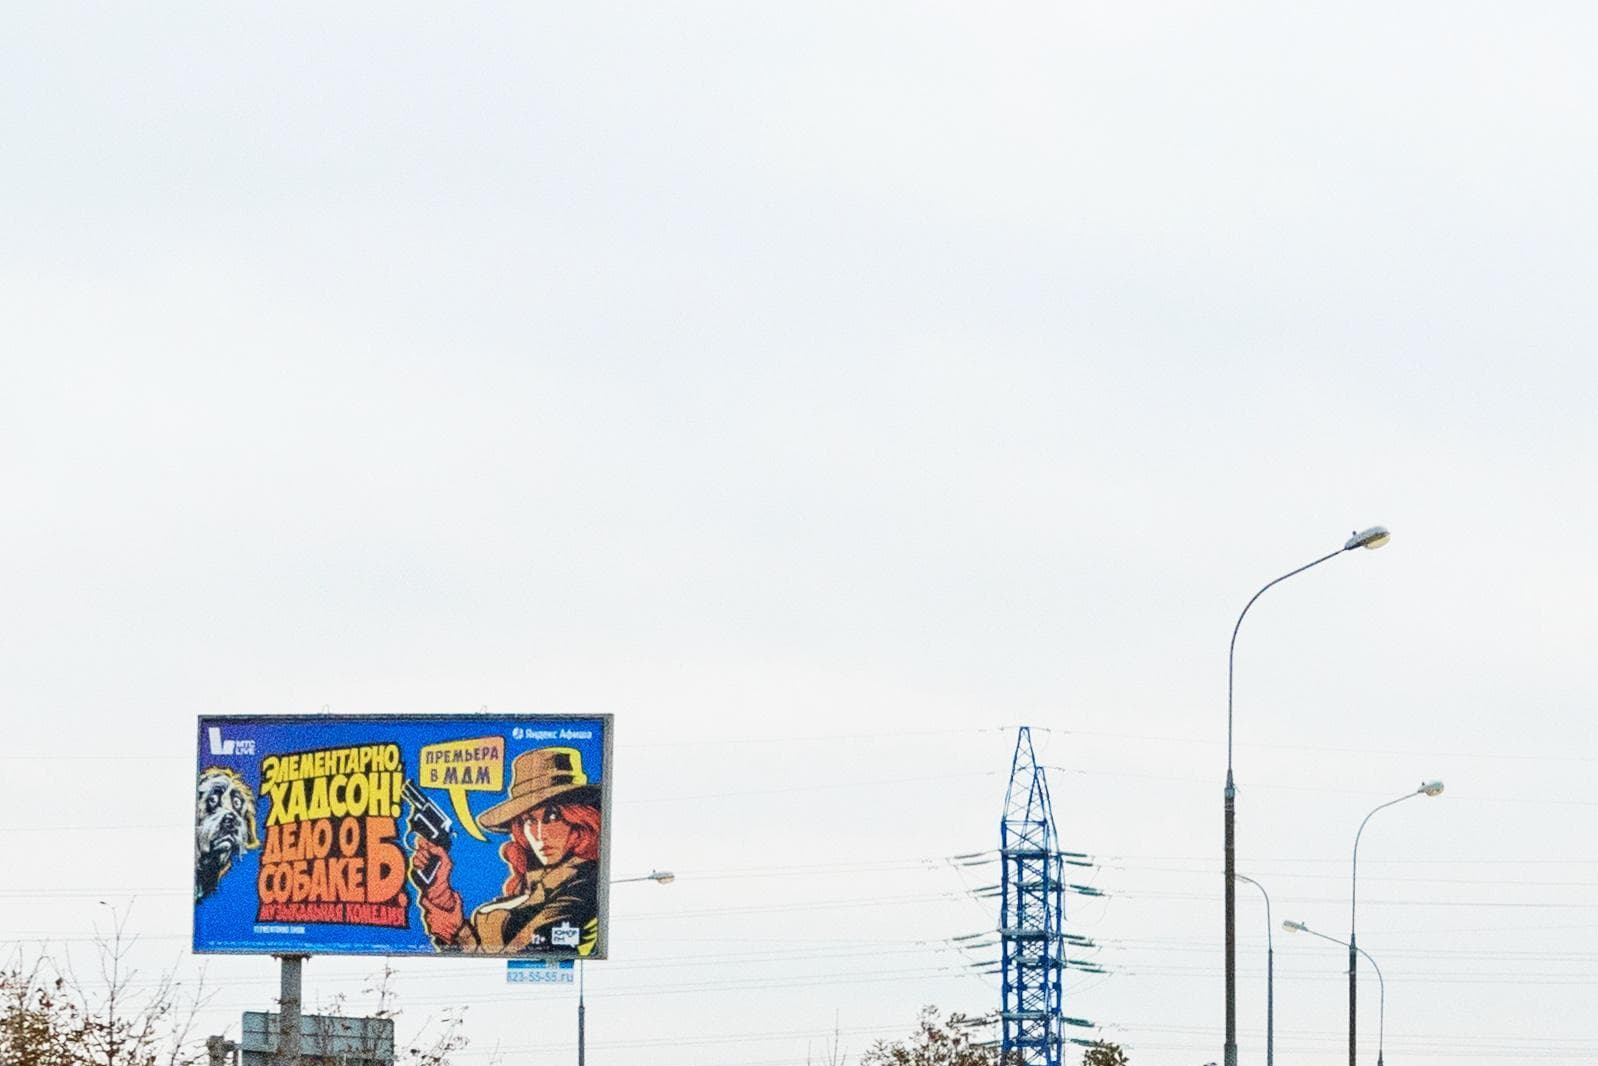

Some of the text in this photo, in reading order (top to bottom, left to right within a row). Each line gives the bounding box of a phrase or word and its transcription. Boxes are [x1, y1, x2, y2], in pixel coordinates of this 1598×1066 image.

[425, 746, 500, 765] ПРЕМЬЕРА
[525, 729, 593, 741] Яндекс Афиша
[261, 744, 403, 795] ЭЛЕМЕНТАРНО,
[443, 766, 491, 785] МДМ
[267, 772, 403, 827] ХАДСОН!
[262, 816, 361, 865] ДЕЛО О
[258, 857, 366, 904] СОБАКЕ
